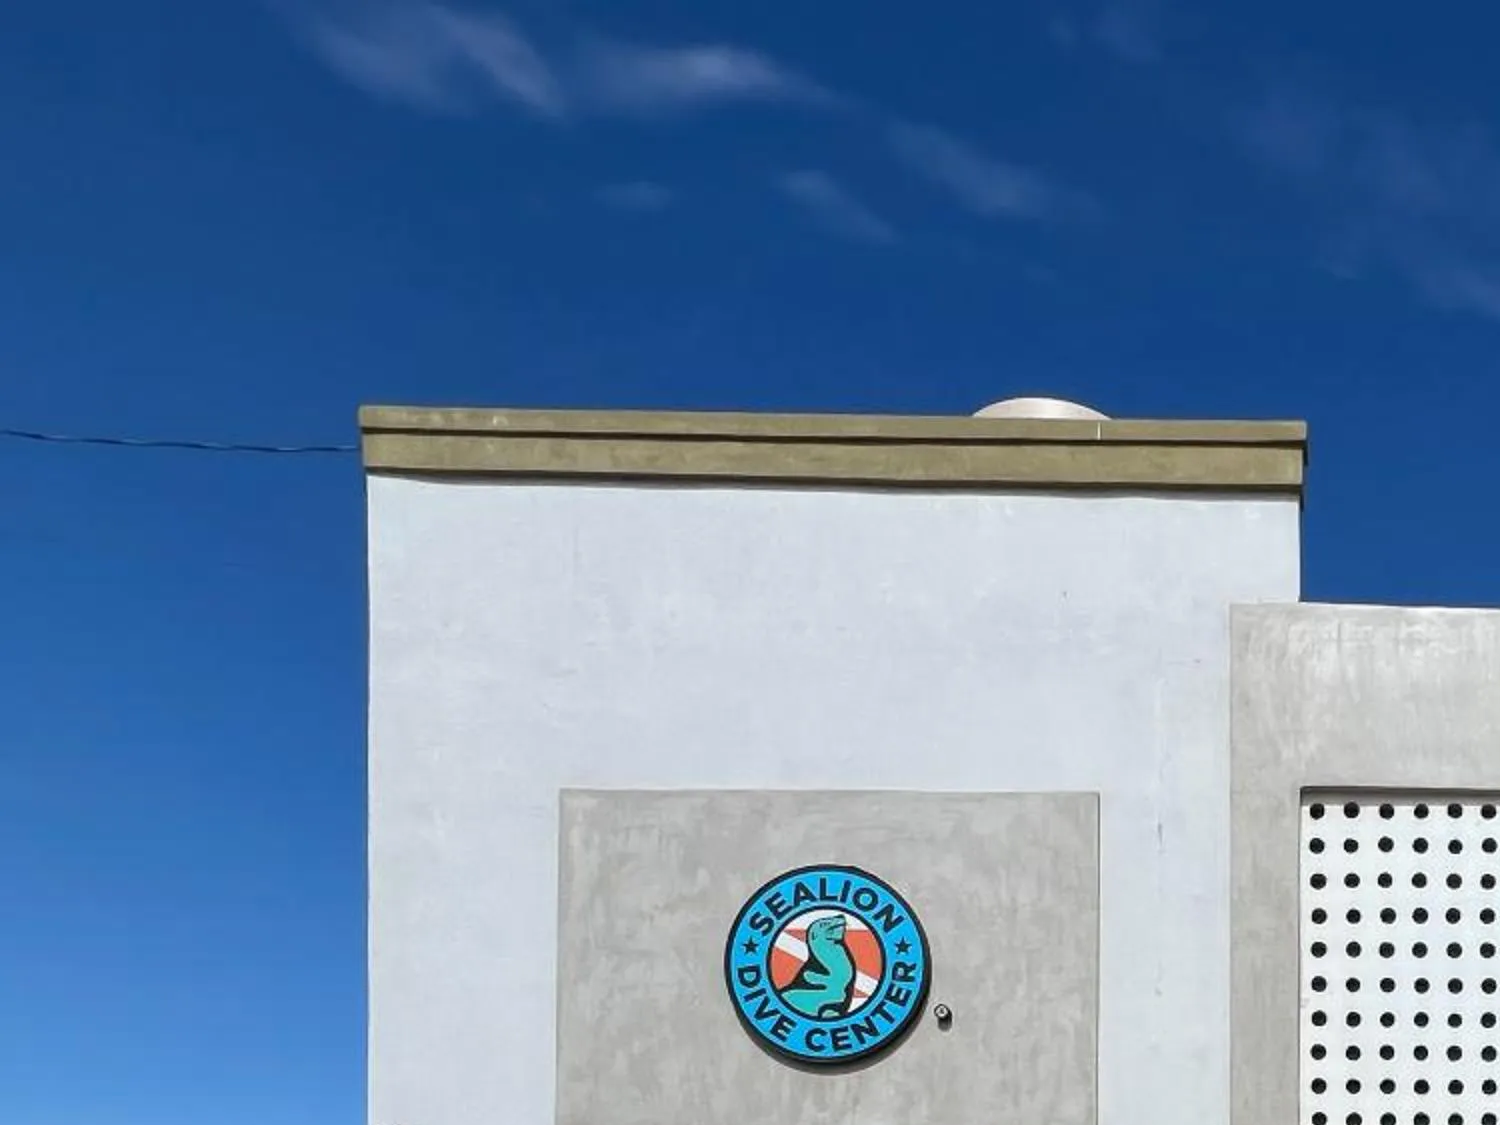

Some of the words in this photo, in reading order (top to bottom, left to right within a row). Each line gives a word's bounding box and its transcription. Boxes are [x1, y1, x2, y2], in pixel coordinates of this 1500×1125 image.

[750, 877, 904, 937] SEALION
[737, 965, 797, 1043] DIVE
[804, 961, 917, 1052] CENTER
